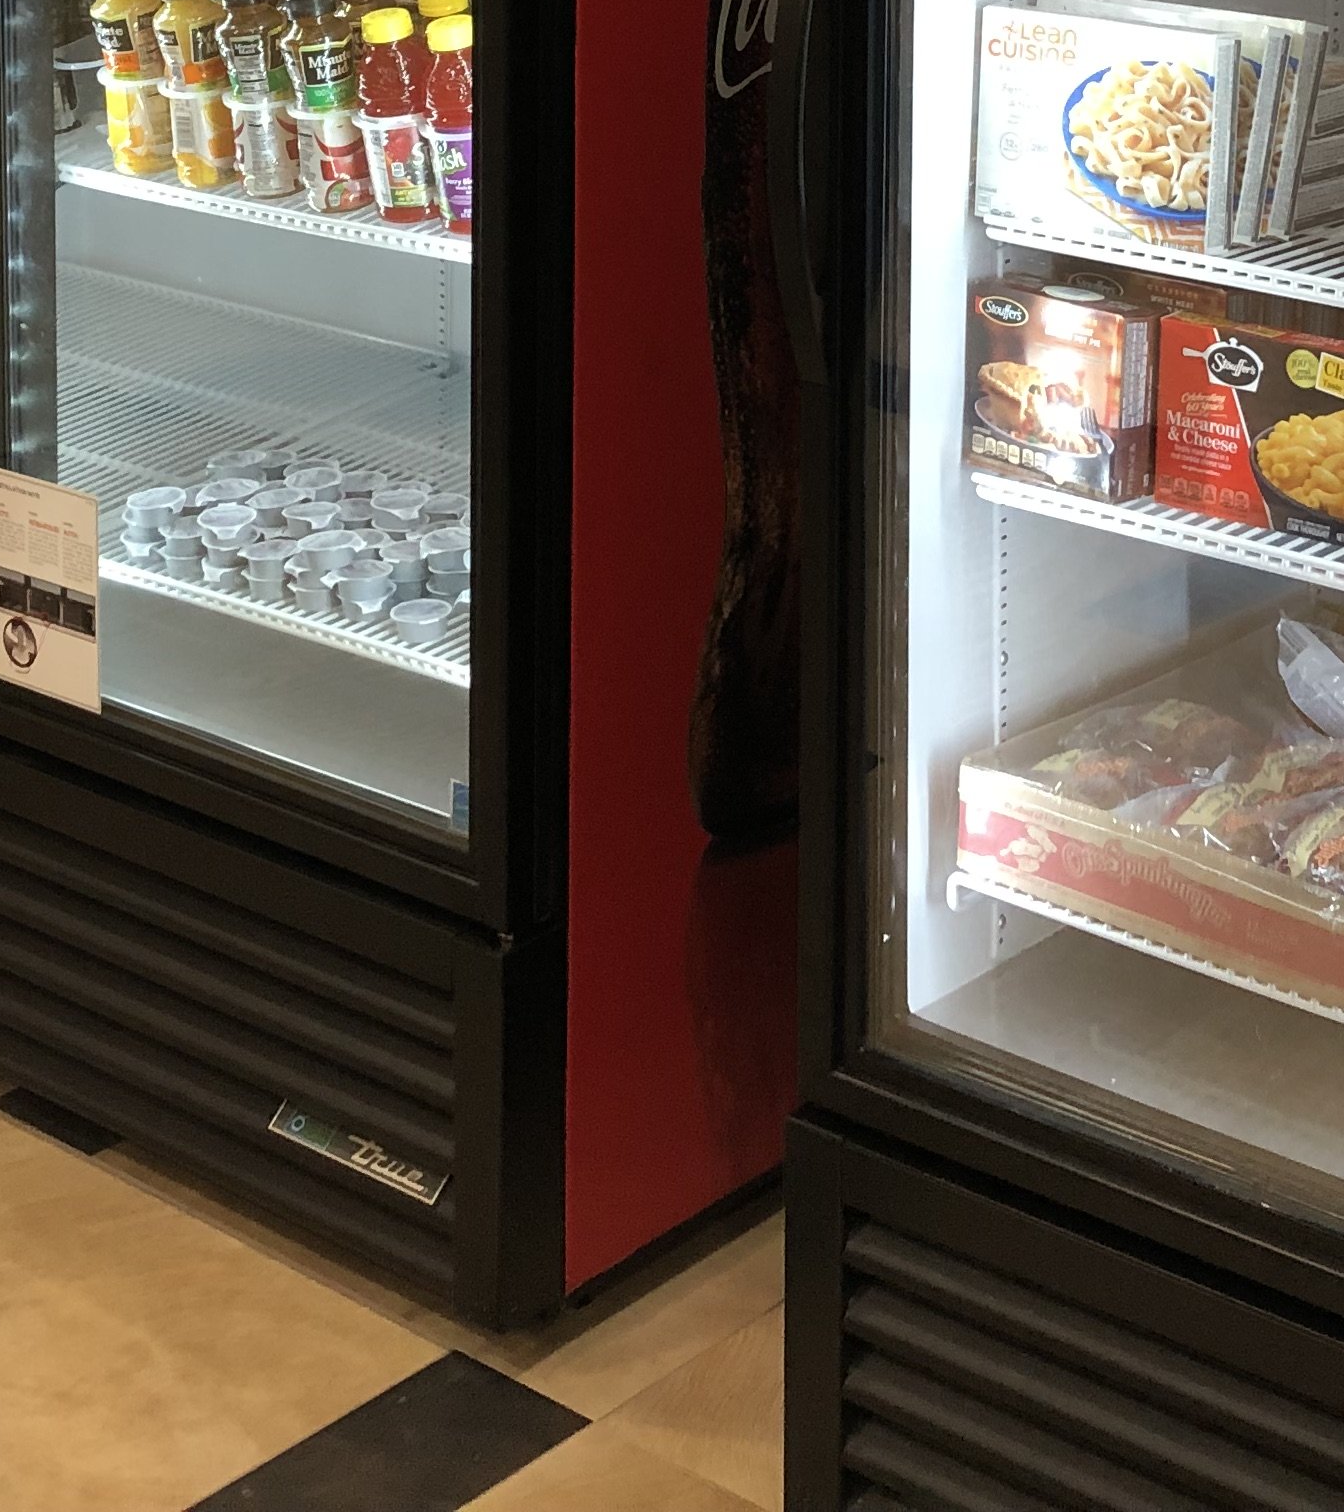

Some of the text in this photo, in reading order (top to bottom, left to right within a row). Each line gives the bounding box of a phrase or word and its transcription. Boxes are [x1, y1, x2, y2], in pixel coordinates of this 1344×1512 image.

[1021, 23, 1077, 46] Lean
[986, 301, 1023, 321] Stouffer's
[1211, 352, 1256, 377] Stouffer's
[1166, 409, 1240, 439] Macaroni
[1167, 425, 1238, 454] & Cheese
